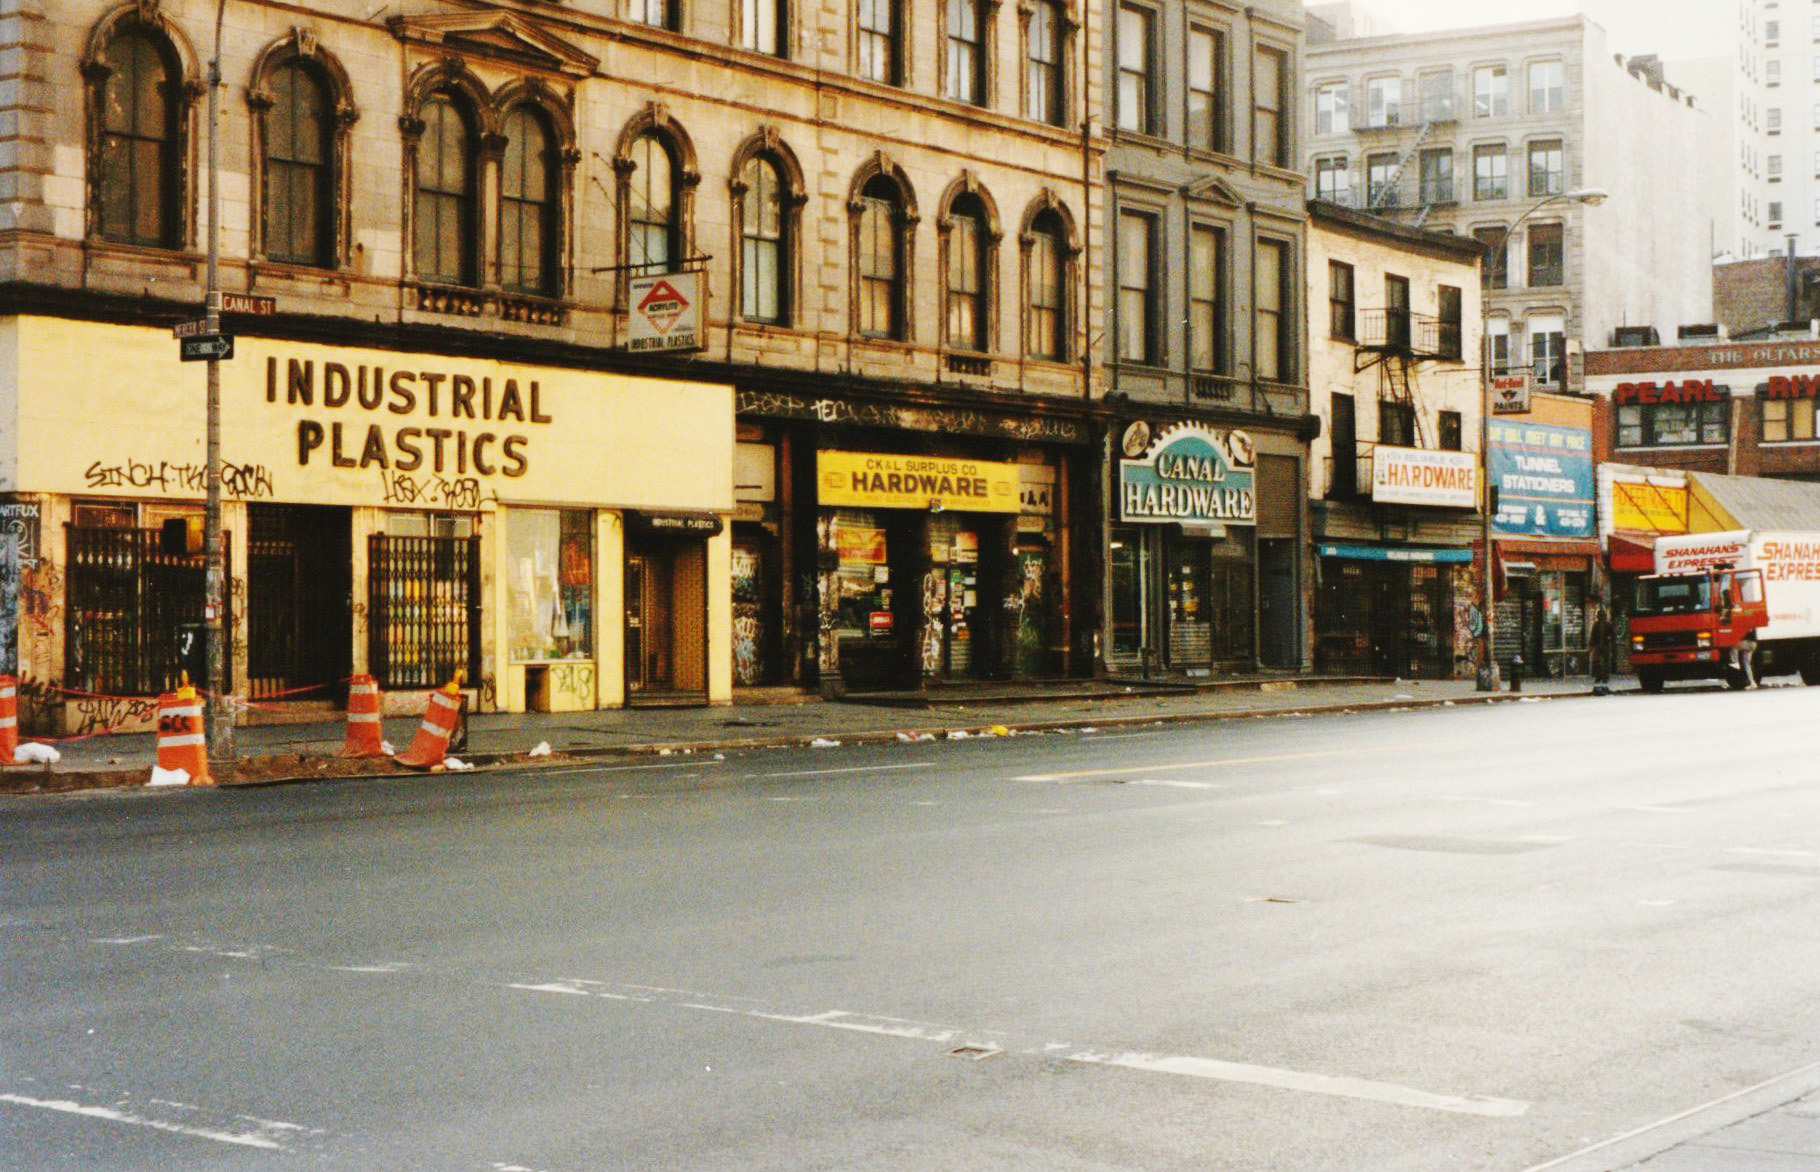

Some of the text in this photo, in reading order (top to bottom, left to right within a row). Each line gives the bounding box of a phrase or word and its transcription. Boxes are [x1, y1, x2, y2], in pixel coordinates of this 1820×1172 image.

[223, 296, 273, 314] CANAL ST
[631, 334, 694, 350] INDUSTRIAL PLASTICS
[1711, 350, 1744, 364] THE
[266, 356, 552, 424] INDUSTRIAL
[1616, 379, 1721, 405] PEARL
[1494, 401, 1524, 410] PAINTS
[297, 419, 528, 477] PLASTICS
[906, 461, 958, 475] SURPLUS
[1155, 452, 1227, 482] CANAL
[1514, 455, 1562, 474] TUNNEL
[851, 470, 989, 498] HARDWARE
[1388, 463, 1474, 490] HARDWARE
[1503, 474, 1575, 494] STATIONERS
[1125, 483, 1253, 519] HARDWARE
[1535, 504, 1547, 526] &
